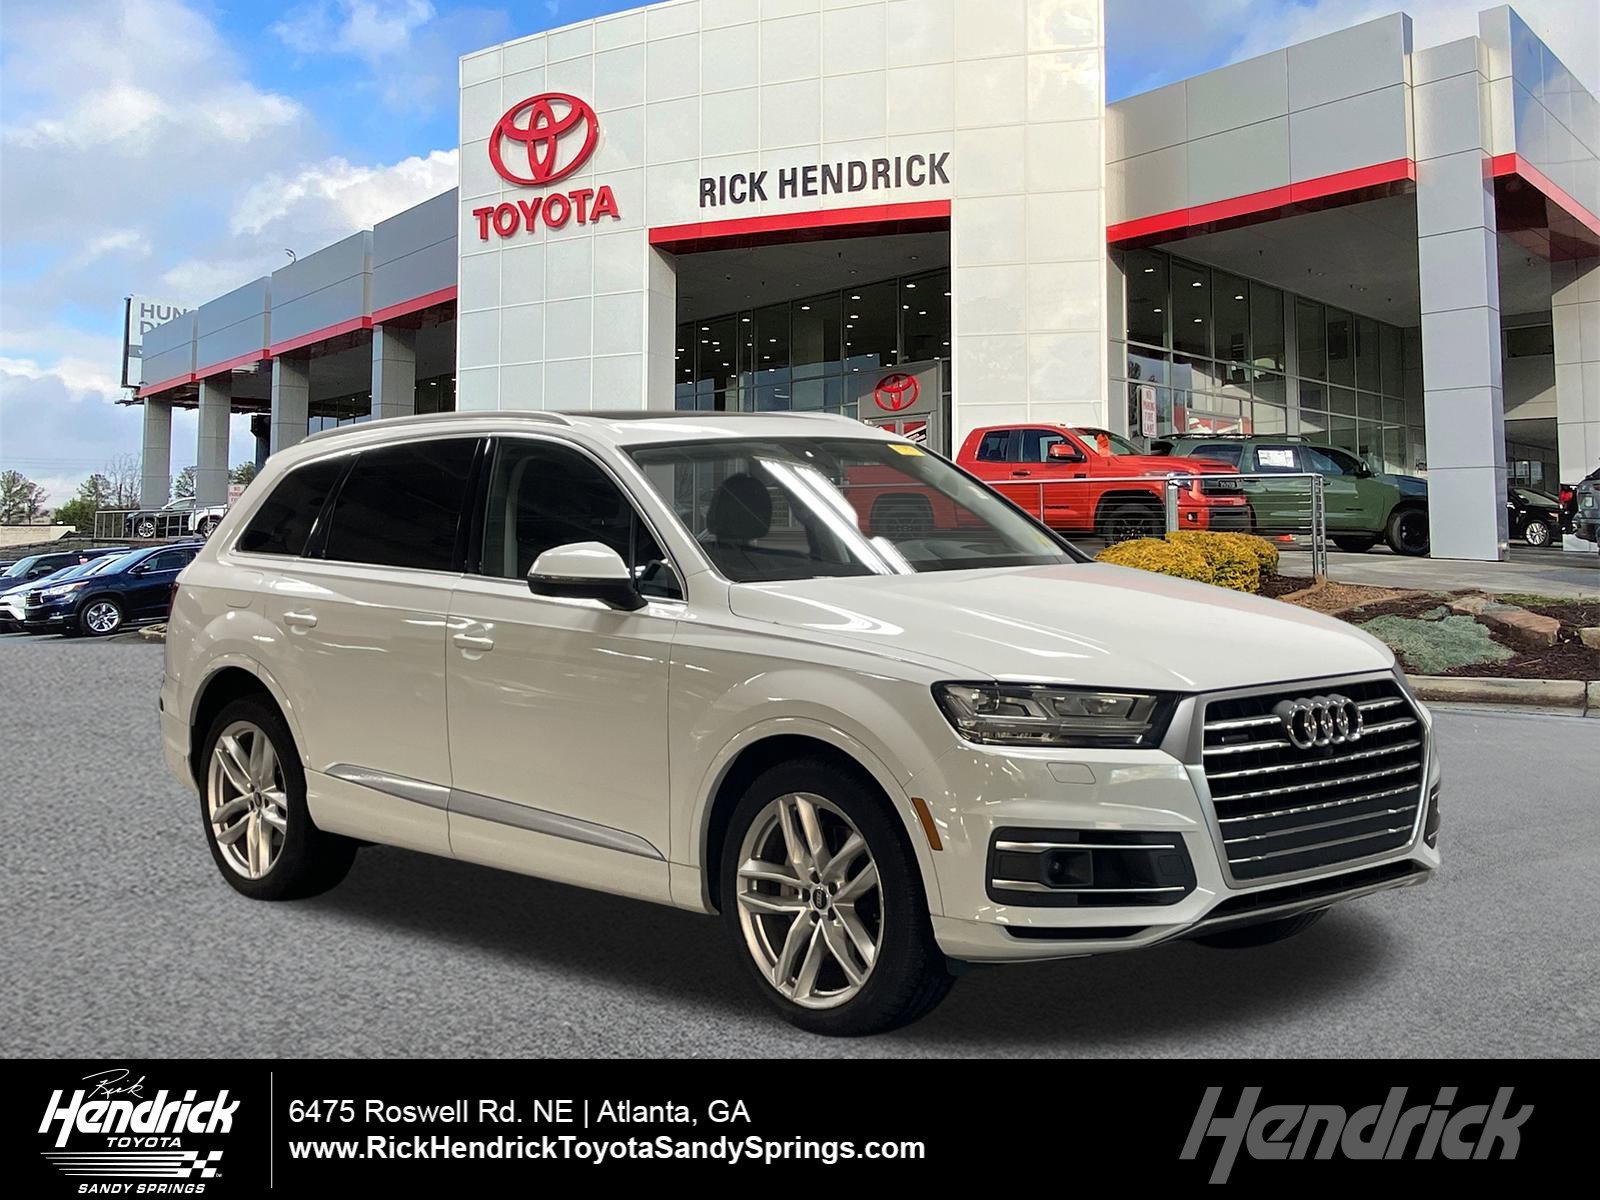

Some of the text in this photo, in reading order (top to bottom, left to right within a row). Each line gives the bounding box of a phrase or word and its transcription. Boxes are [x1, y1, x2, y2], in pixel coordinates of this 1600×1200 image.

[699, 152, 950, 207] RICK HENDRICK
[473, 185, 620, 240] TOYOTA
